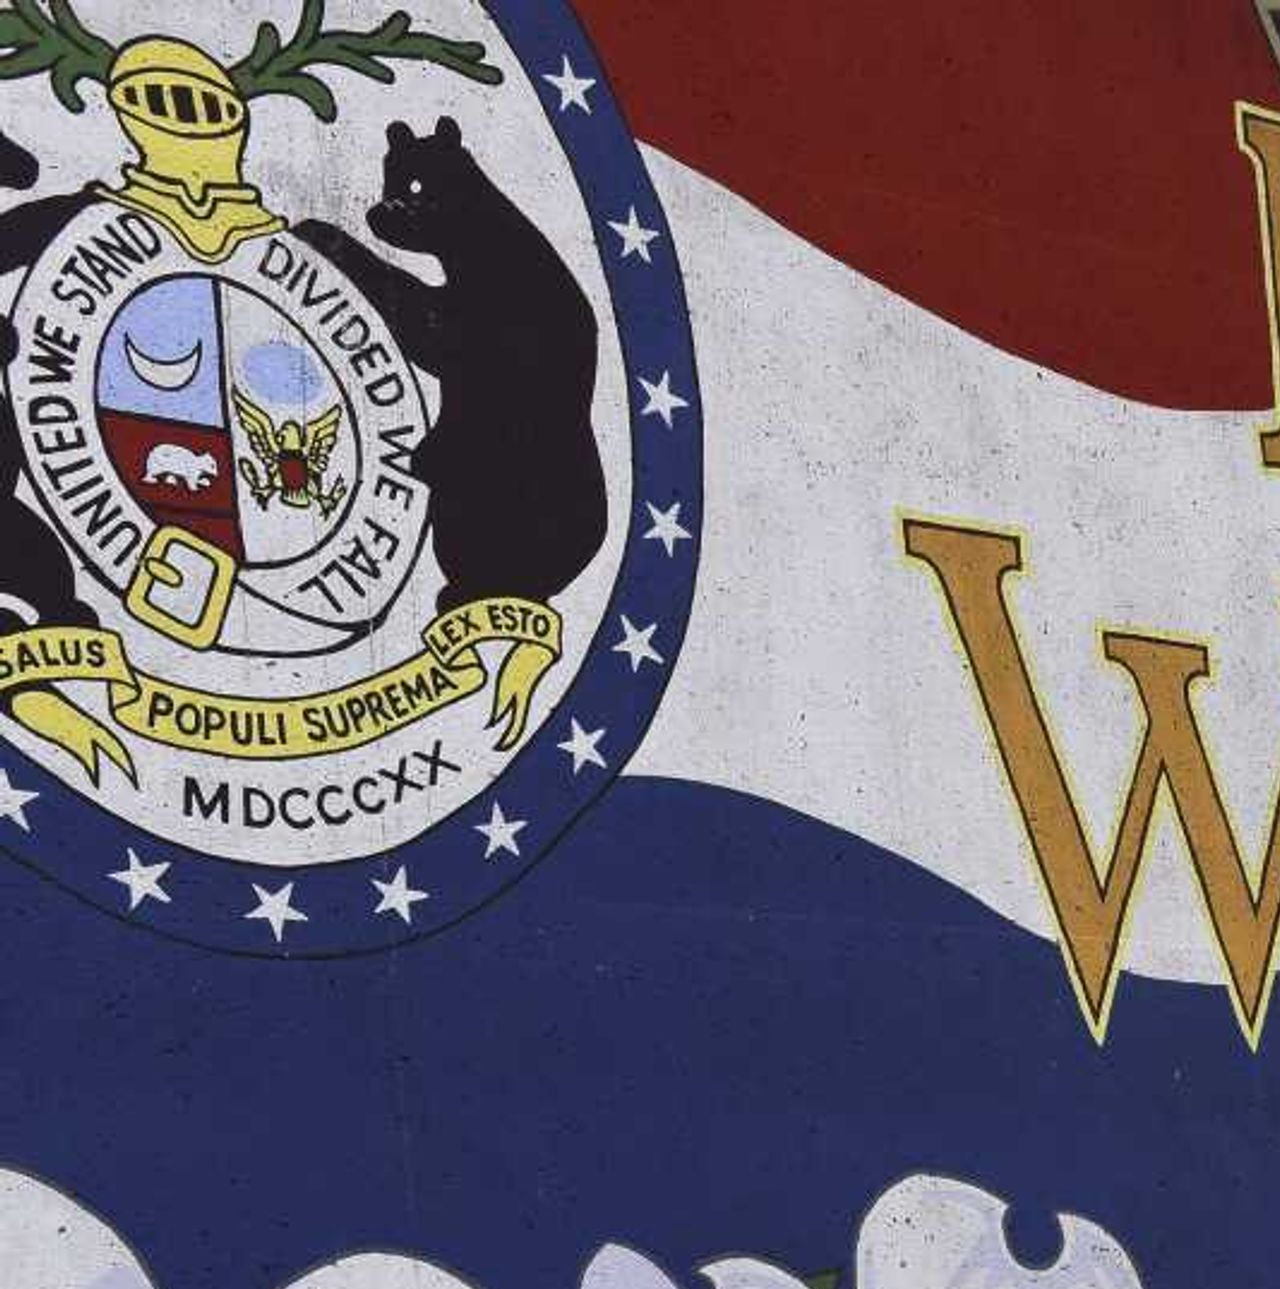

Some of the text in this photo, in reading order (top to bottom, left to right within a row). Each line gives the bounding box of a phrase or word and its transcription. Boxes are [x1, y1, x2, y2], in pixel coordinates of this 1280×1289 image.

[28, 211, 163, 567] UNITED WE STAND
[258, 238, 414, 614] DIVIDED WE FALL
[0, 641, 106, 678] SALUS
[429, 604, 550, 654] LEX ESTO
[147, 668, 459, 745] POPULI SUPREMA
[182, 740, 462, 830] MDCCCXX
